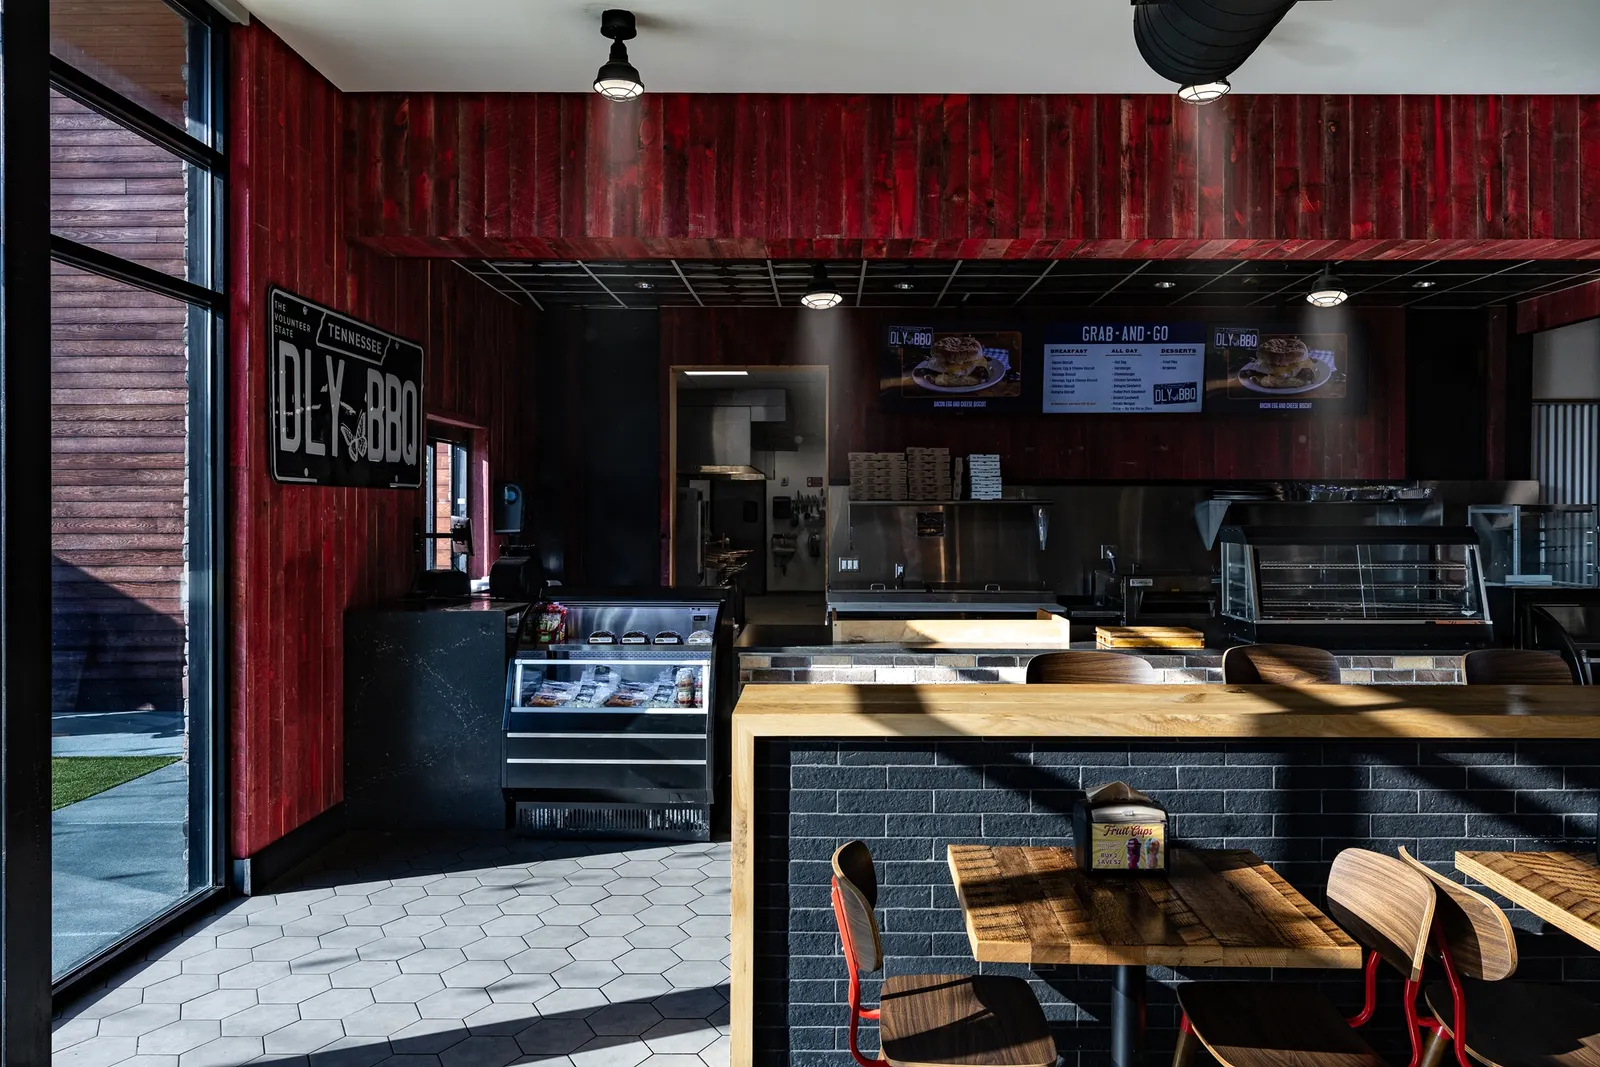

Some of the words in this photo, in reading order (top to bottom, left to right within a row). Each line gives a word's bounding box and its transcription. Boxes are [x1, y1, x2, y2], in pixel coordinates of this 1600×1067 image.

[274, 300, 286, 312] THE
[274, 312, 311, 333] VOLUNTEER
[274, 324, 294, 338] STATE
[328, 322, 382, 354] TENNESSEE
[1082, 326, 1114, 342] GRAB
[1122, 326, 1144, 342] AND
[1152, 326, 1168, 342] GO
[890, 332, 908, 344] DLY
[914, 332, 932, 346] BBQ
[1216, 333, 1234, 346] DLY
[1240, 334, 1257, 347] BBQ
[1155, 388, 1172, 402] DLY
[1179, 387, 1196, 401] BBQ
[278, 340, 345, 458] DLY
[367, 368, 418, 466] BBQ
[1103, 824, 1130, 836] Fruit
[1130, 825, 1152, 838] Cups
